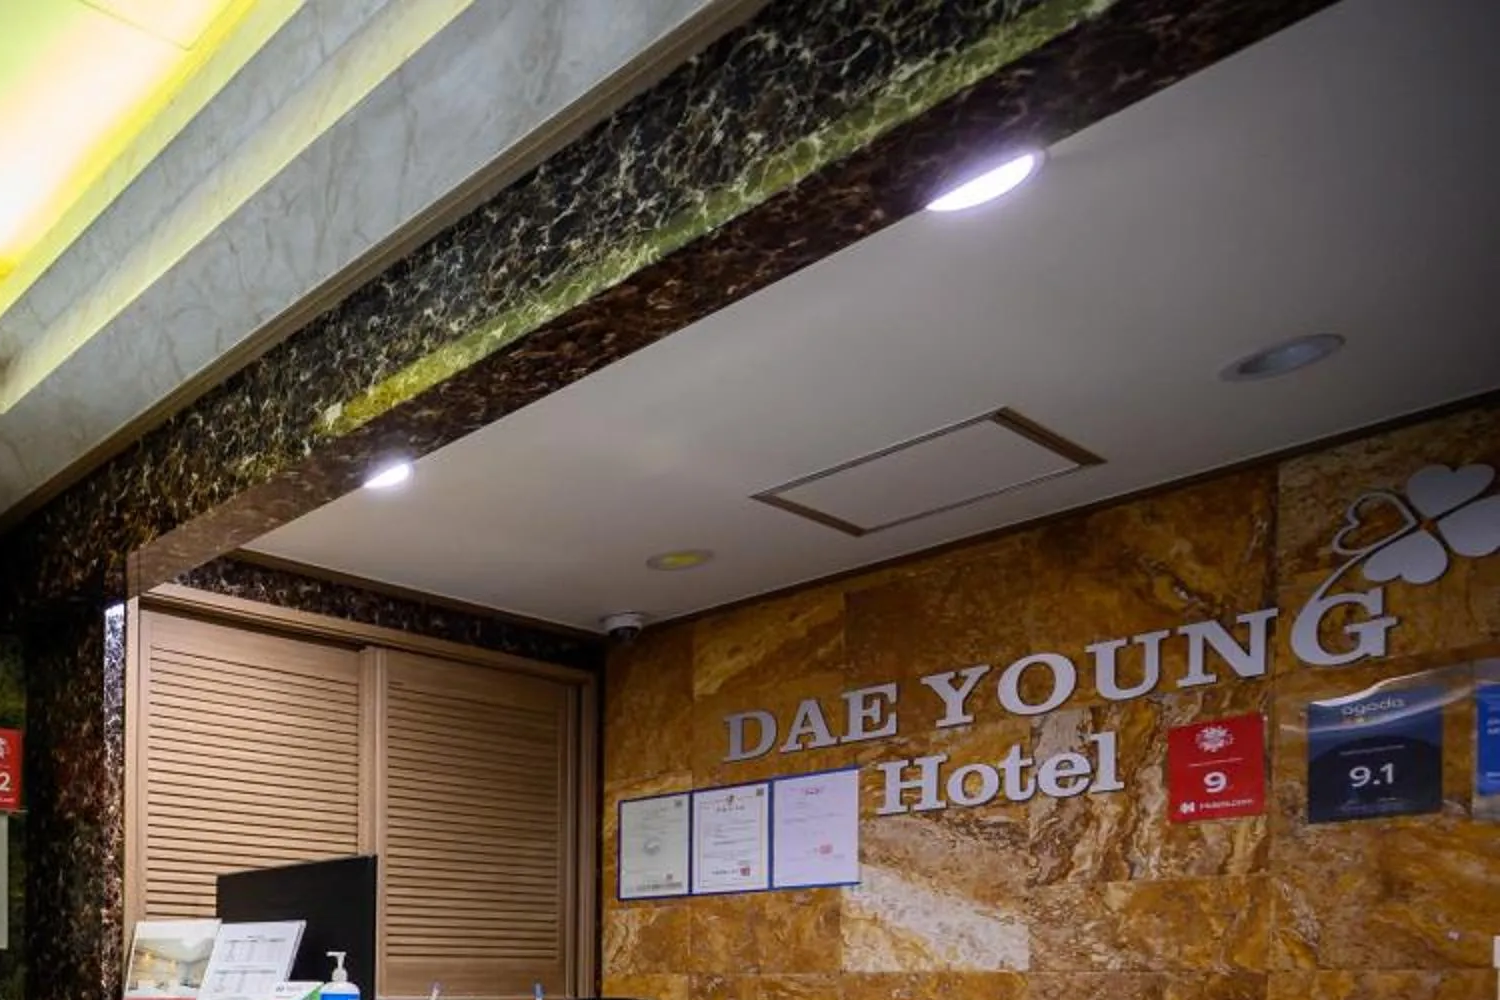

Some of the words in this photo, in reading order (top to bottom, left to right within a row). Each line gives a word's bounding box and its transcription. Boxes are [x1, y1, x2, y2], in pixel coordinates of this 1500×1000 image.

[723, 682, 900, 764] DAE
[921, 588, 1397, 730] YOUNG
[1340, 696, 1406, 716] agoda
[876, 732, 1125, 816] Hotel
[1203, 771, 1228, 794] 9
[1348, 762, 1396, 788] 9.1
